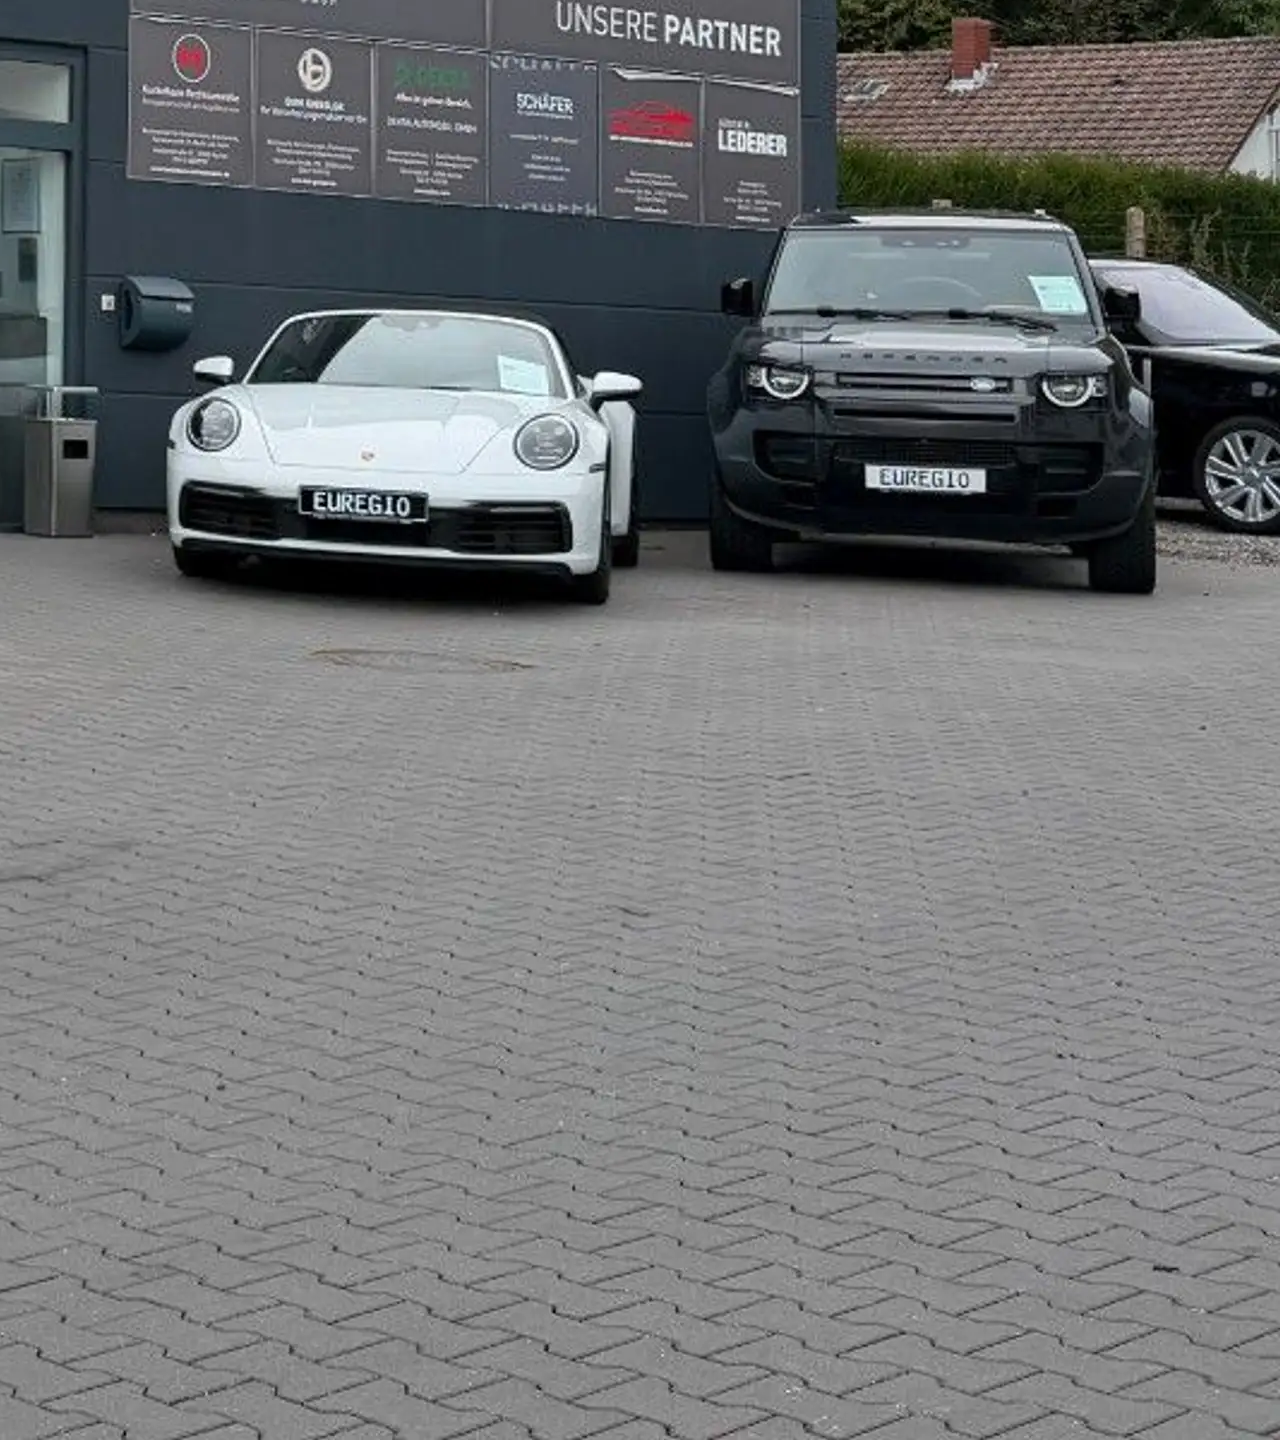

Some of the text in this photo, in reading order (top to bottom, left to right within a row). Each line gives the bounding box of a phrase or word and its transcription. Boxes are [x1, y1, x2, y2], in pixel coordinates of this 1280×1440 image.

[556, 0, 782, 57] UNSERE PARTNER
[718, 127, 788, 157] LEDERER
[879, 467, 970, 489] EUREGIO
[312, 490, 411, 517] EUREGIO
